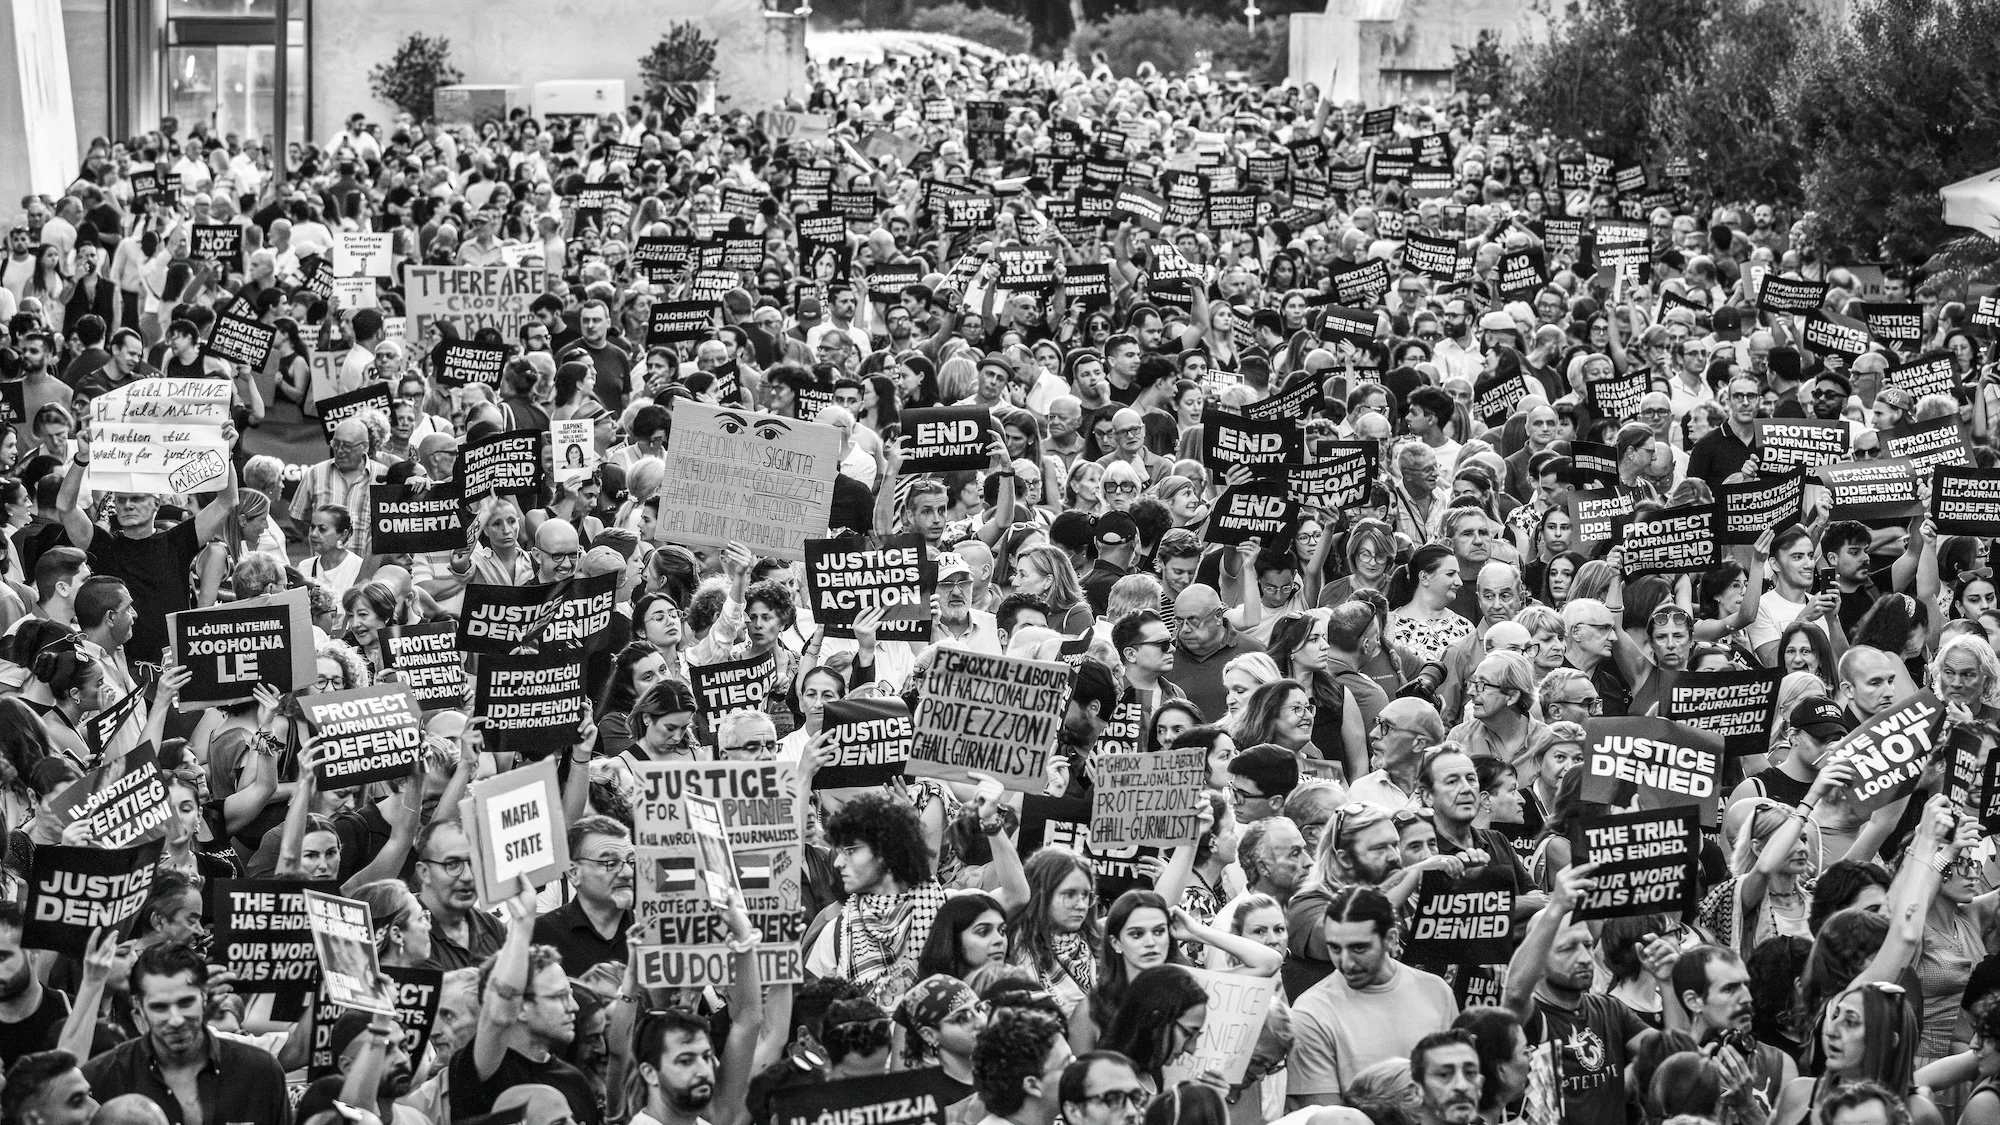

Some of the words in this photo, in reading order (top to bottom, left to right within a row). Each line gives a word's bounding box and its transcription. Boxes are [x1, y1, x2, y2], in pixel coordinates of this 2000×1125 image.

[954, 207, 987, 220] NOT
[967, 199, 992, 207] WILL
[1082, 197, 1114, 210] END
[801, 216, 843, 228] JUSTICE
[1597, 226, 1648, 238] JUSTICE
[200, 237, 233, 250] NOT
[638, 244, 689, 252] JUSTICE
[726, 240, 763, 248] PROTECT
[1151, 245, 1173, 255] WE
[636, 251, 687, 261] DENIED
[1000, 251, 1021, 261] WE
[1022, 251, 1053, 260] WILL
[1006, 260, 1047, 275] NOT
[1506, 255, 1530, 272] NO
[412, 269, 498, 297] THERE
[500, 269, 543, 295] ARE
[871, 273, 919, 284] DAQSHEKK
[1000, 275, 1025, 283] LOOK
[1063, 274, 1106, 285] AQSHEKK
[1153, 271, 1180, 280] LOOK
[1334, 261, 1383, 283] PROTECT
[1503, 266, 1536, 283] MORE
[447, 295, 523, 313] CROOKS
[656, 310, 710, 321] DAQSHEKK
[220, 317, 274, 342] PROTECT
[1809, 320, 1868, 342] JUSTICE
[1868, 314, 1921, 327] JUSTICE
[1869, 324, 1921, 340] DENIED
[214, 333, 266, 360] DEFEND
[446, 346, 503, 362] JUSTICE
[1806, 331, 1867, 355] DENIED
[443, 366, 499, 383] ACTION
[444, 355, 501, 371] DEMANDS
[1932, 358, 1951, 373] SE
[1480, 376, 1523, 405] JUSTICE
[1594, 379, 1631, 393] MHUX
[1632, 373, 1646, 386] SE
[1483, 388, 1531, 420] DENIED
[94, 430, 105, 442] A
[111, 432, 151, 443] nation
[162, 431, 191, 442] still
[917, 420, 979, 445] END
[1218, 426, 1283, 453] END
[1762, 424, 1845, 442] PROTECT
[1887, 425, 1959, 451] IPPROTEĠU
[465, 437, 536, 464] PROTECT
[1212, 447, 1287, 465] IMPUNITY
[1762, 436, 1845, 453] JOURNALISTS.
[464, 451, 537, 475] JOURNALISTS.
[1288, 454, 1367, 479] L-IMPUNITÀ
[1763, 447, 1841, 467] DEFEND
[173, 460, 224, 493] MATTERS
[465, 462, 536, 488] DEFEND
[1288, 467, 1366, 494] TIEQAF
[465, 477, 536, 498] DEMOCRACY.
[1833, 492, 1916, 505] D-DEMOKRAZIJA.
[1834, 481, 1913, 496] IDDEFENDU
[379, 498, 460, 515] DAQSHEKK
[1229, 492, 1287, 518] END
[1727, 496, 1800, 524] IDDEFENDU
[379, 511, 462, 534] OMERTÀ
[1219, 515, 1287, 534] IMPUNITY
[1622, 513, 1713, 539] PROTECT
[1623, 540, 1714, 564] DEFEND
[1624, 530, 1714, 551] JOURNALISTS.
[816, 548, 919, 571] JUSTICE
[1624, 557, 1715, 577] DEMOCRACY.
[816, 567, 920, 589] DEMANDS
[821, 584, 922, 610] ACTION
[471, 595, 565, 623] JUSTICE
[187, 623, 234, 637] IL-ĠURI
[235, 619, 284, 634] NTEMM.
[542, 610, 611, 643] DENIED
[388, 632, 457, 655] PROTECT
[217, 652, 263, 683] LE.
[392, 650, 461, 668] JOURNALISTS.
[701, 654, 776, 687] L-IMPUNITÀ
[397, 665, 462, 688] DEFEND
[490, 663, 581, 686] IPPROTEĠU
[489, 679, 580, 698] LILL-ĠURNALISTI.
[703, 671, 778, 708] TIEQAF
[1672, 681, 1773, 702] IPPROTEĠU
[312, 693, 408, 724] PROTECT
[487, 696, 581, 719] IDDEFENDU
[1671, 695, 1769, 714] LILL-ĠURNALISTI.
[318, 712, 417, 739] JOURNALISTS.
[484, 711, 581, 730] D-DEMOKRAZIJA.
[828, 716, 913, 745] JUSTICE
[919, 697, 1052, 746] PROTEZZJONI
[1870, 701, 1937, 737] WILL
[323, 728, 421, 762] DEFEND
[824, 739, 913, 768] DENIED
[1593, 734, 1716, 775] JUSTICE
[1849, 718, 1933, 780] NOT
[325, 748, 426, 778] DEMOCRACY.
[645, 766, 780, 801] JUSTICE
[1590, 754, 1714, 799] DENIED
[1853, 767, 1907, 802] LOOK
[68, 761, 158, 820] IL-ĠUSTIZZJA
[1098, 788, 1200, 815] PROTEZZJONI
[501, 799, 539, 830] MAFIA
[646, 803, 680, 822] FOR
[1585, 826, 1628, 849] THE
[1631, 818, 1690, 844] TRIAL
[504, 832, 543, 863] STATE
[1588, 844, 1624, 865] HAS
[1626, 839, 1688, 860] ENDED.
[39, 862, 156, 898] JUSTICE
[1629, 864, 1686, 888] WORK
[229, 892, 276, 912] THE
[1422, 890, 1512, 917] JUSTICE
[1625, 881, 1682, 906] NOT.
[34, 888, 150, 928] DENIED
[642, 899, 699, 917] PROTECT
[230, 913, 268, 930] HAS
[1414, 915, 1510, 941] DENIED
[227, 943, 268, 961] OUR
[227, 961, 271, 981] HAS
[644, 951, 685, 985] EU
[688, 952, 723, 985] DO
